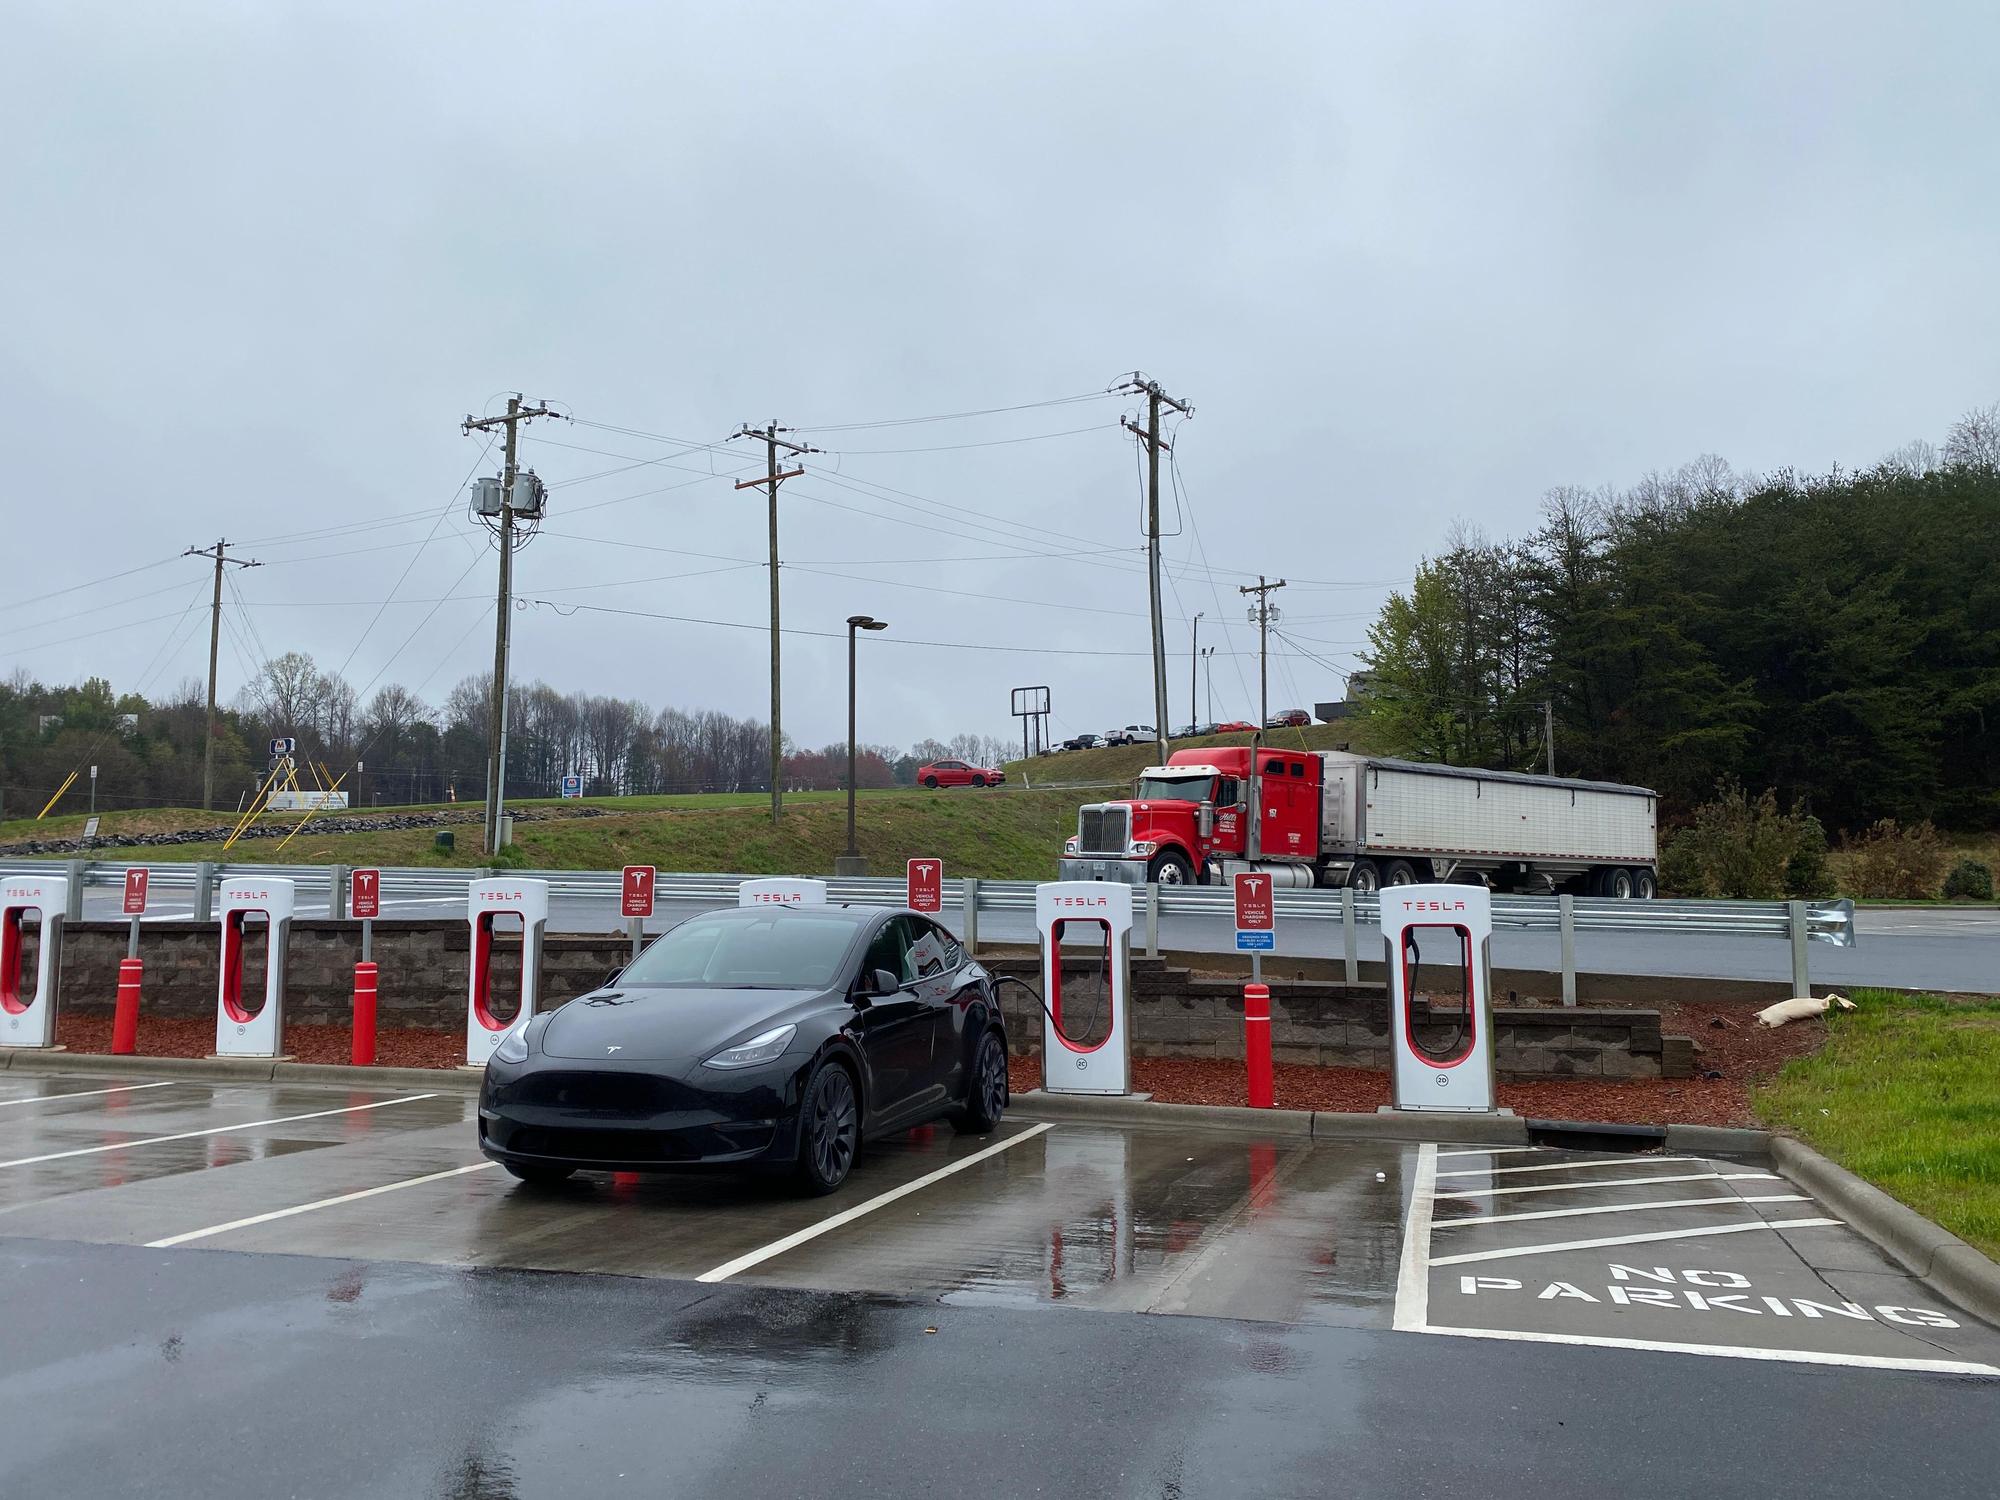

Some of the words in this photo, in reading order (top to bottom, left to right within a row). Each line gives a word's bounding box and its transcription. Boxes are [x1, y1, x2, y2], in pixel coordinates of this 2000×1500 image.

[6, 889, 41, 897] TESLA
[229, 891, 268, 899] TESLA
[479, 892, 522, 901] TESLA
[753, 893, 801, 902] TESLA
[1053, 897, 1107, 907] TESLA
[1402, 901, 1466, 911] TESLA
[1608, 1263, 1752, 1288] NO
[1460, 1276, 1961, 1329] PARKING
